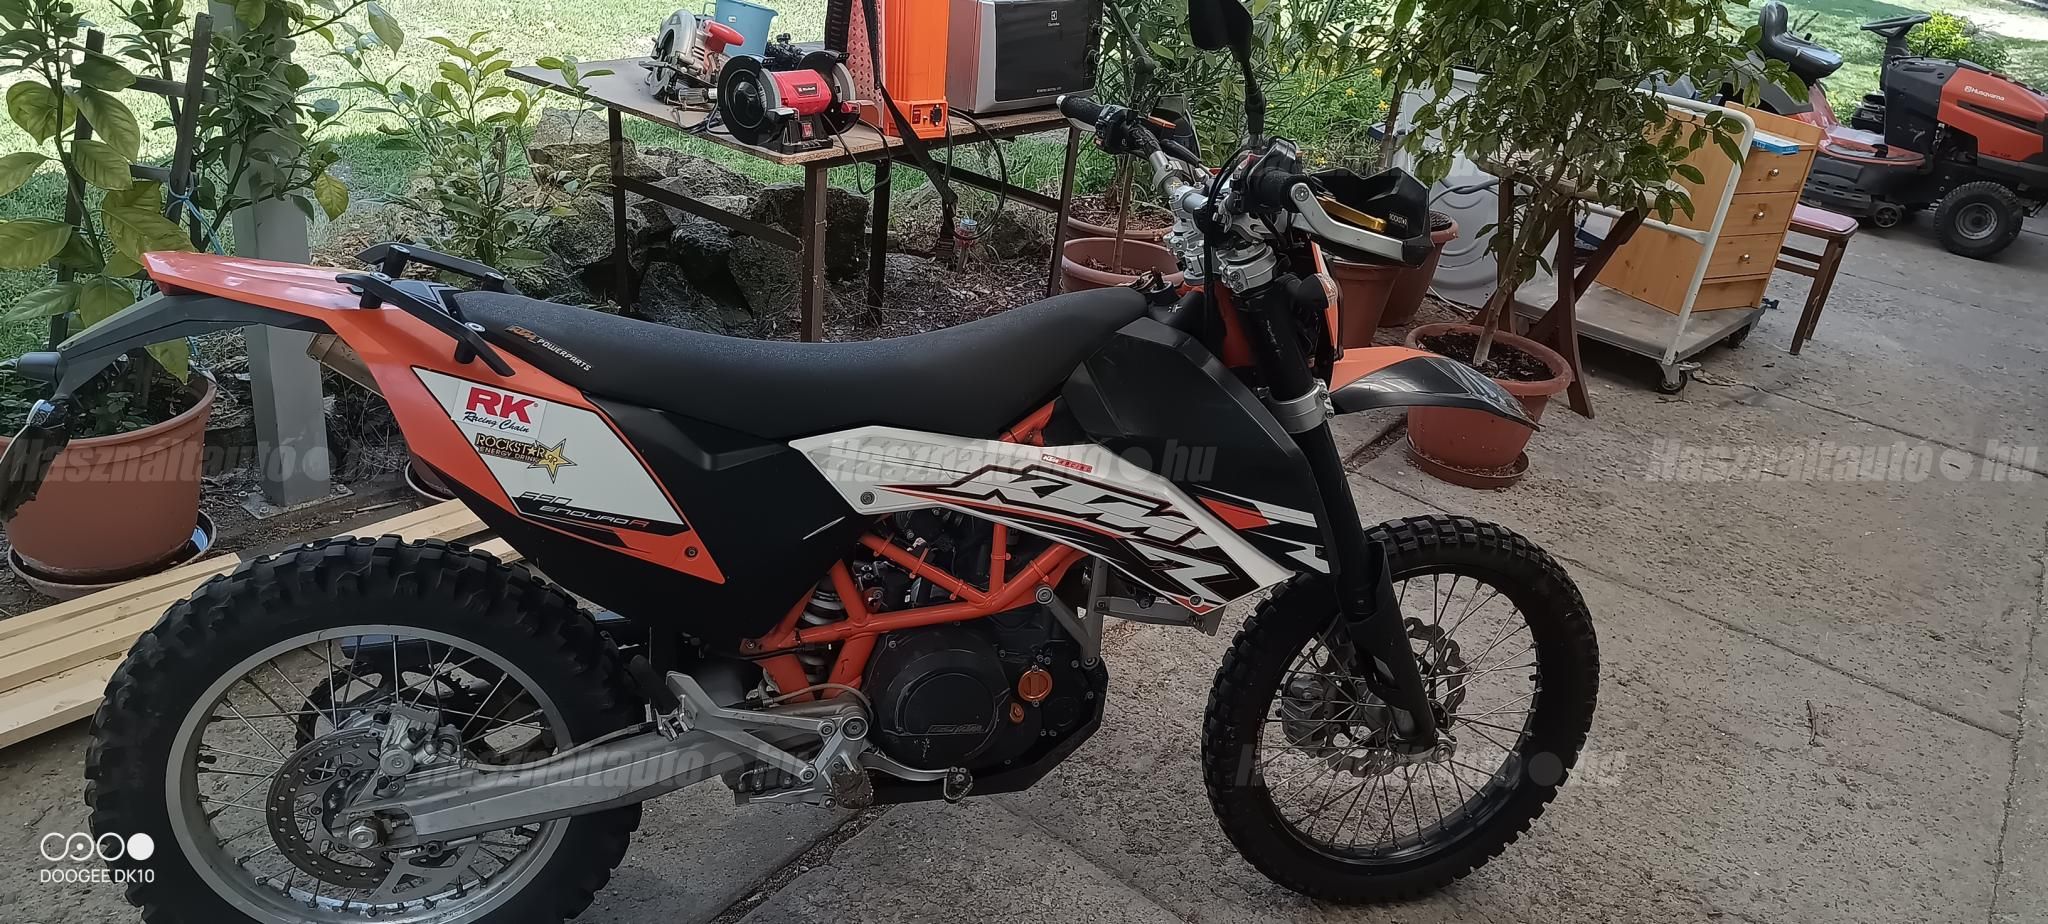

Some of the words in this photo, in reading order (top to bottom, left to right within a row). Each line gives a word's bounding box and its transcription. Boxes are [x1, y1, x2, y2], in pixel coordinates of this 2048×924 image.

[536, 338, 592, 371] POWERPARTS
[465, 386, 535, 425] RK
[462, 411, 498, 428] Racing
[498, 419, 530, 434] Chain
[479, 445, 512, 458] ENERGY
[514, 452, 540, 463] DRINK
[539, 505, 630, 525] ENDURO
[628, 519, 650, 528] R
